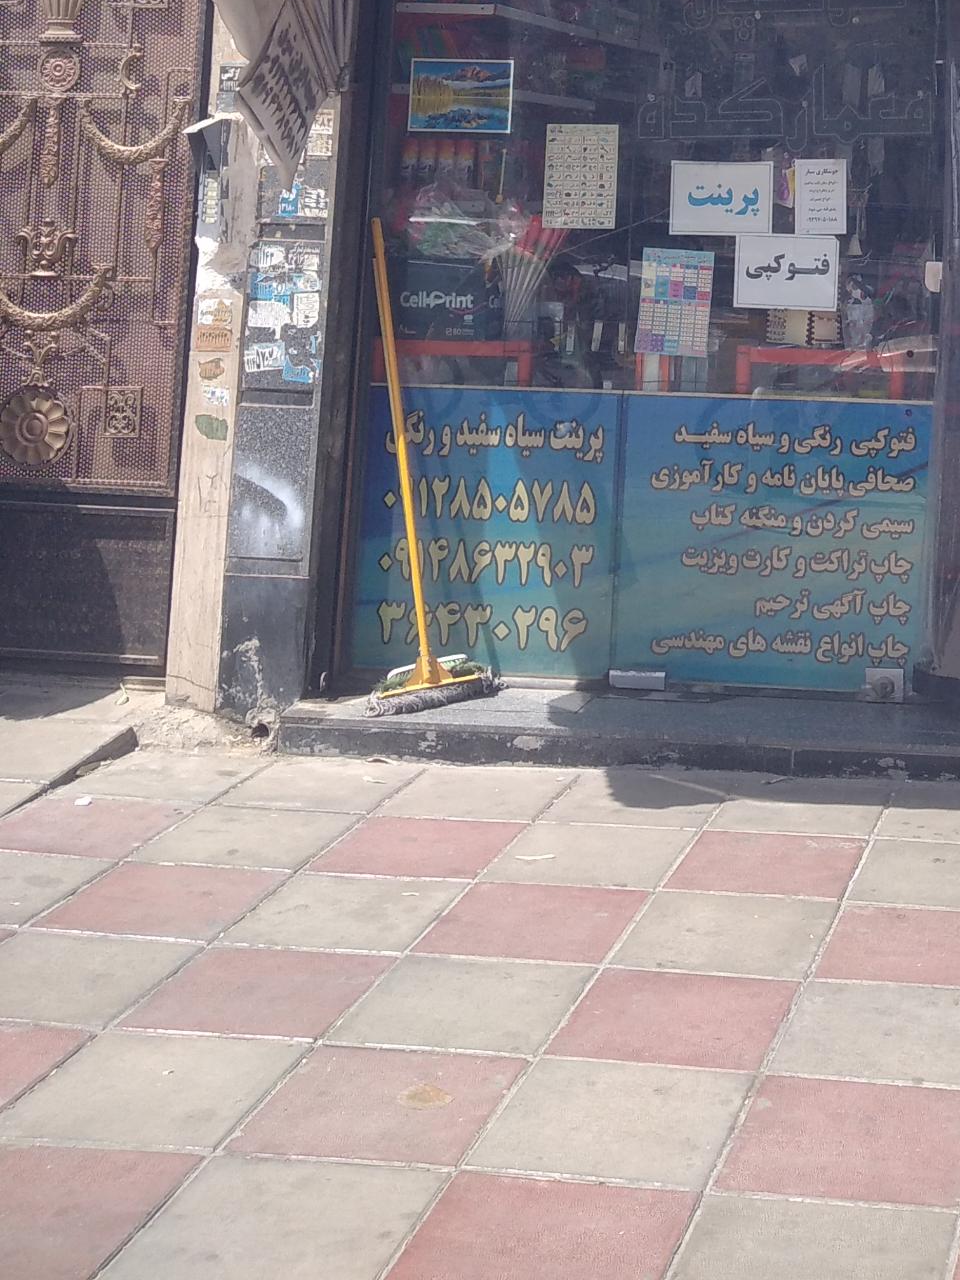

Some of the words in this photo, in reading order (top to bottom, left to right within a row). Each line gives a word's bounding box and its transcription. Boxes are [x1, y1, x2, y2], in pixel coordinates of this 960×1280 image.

[687, 184, 760, 216] پرینت
[438, 424, 453, 457] و
[456, 412, 501, 456] سفید
[505, 412, 545, 458] سیاه
[550, 421, 605, 463] پرینت
[674, 422, 732, 449] سفید
[736, 421, 775, 452] سیاه
[779, 433, 789, 454] و
[794, 424, 843, 455] رنگی
[851, 427, 917, 457] فتوکپی
[383, 476, 597, 526] ۰۱۲۸۵۰۵۷۸۵
[691, 502, 736, 530] کتاب
[740, 505, 786, 530] منگنه
[792, 518, 802, 537] و
[806, 508, 858, 538] کردن
[862, 519, 914, 538] سیمی
[681, 546, 738, 575] ویزیت
[743, 545, 791, 577] کارت
[795, 559, 805, 578] و
[810, 551, 867, 581] تراکت
[870, 548, 913, 584] چاپ
[755, 588, 810, 621] ترحیم
[812, 589, 866, 622] آگهی
[868, 593, 911, 625] چاپ
[651, 628, 724, 655] مهندسی
[729, 628, 766, 658] های
[772, 631, 811, 656] نقشه
[816, 631, 864, 664] انواع
[867, 633, 909, 667] چاپ
